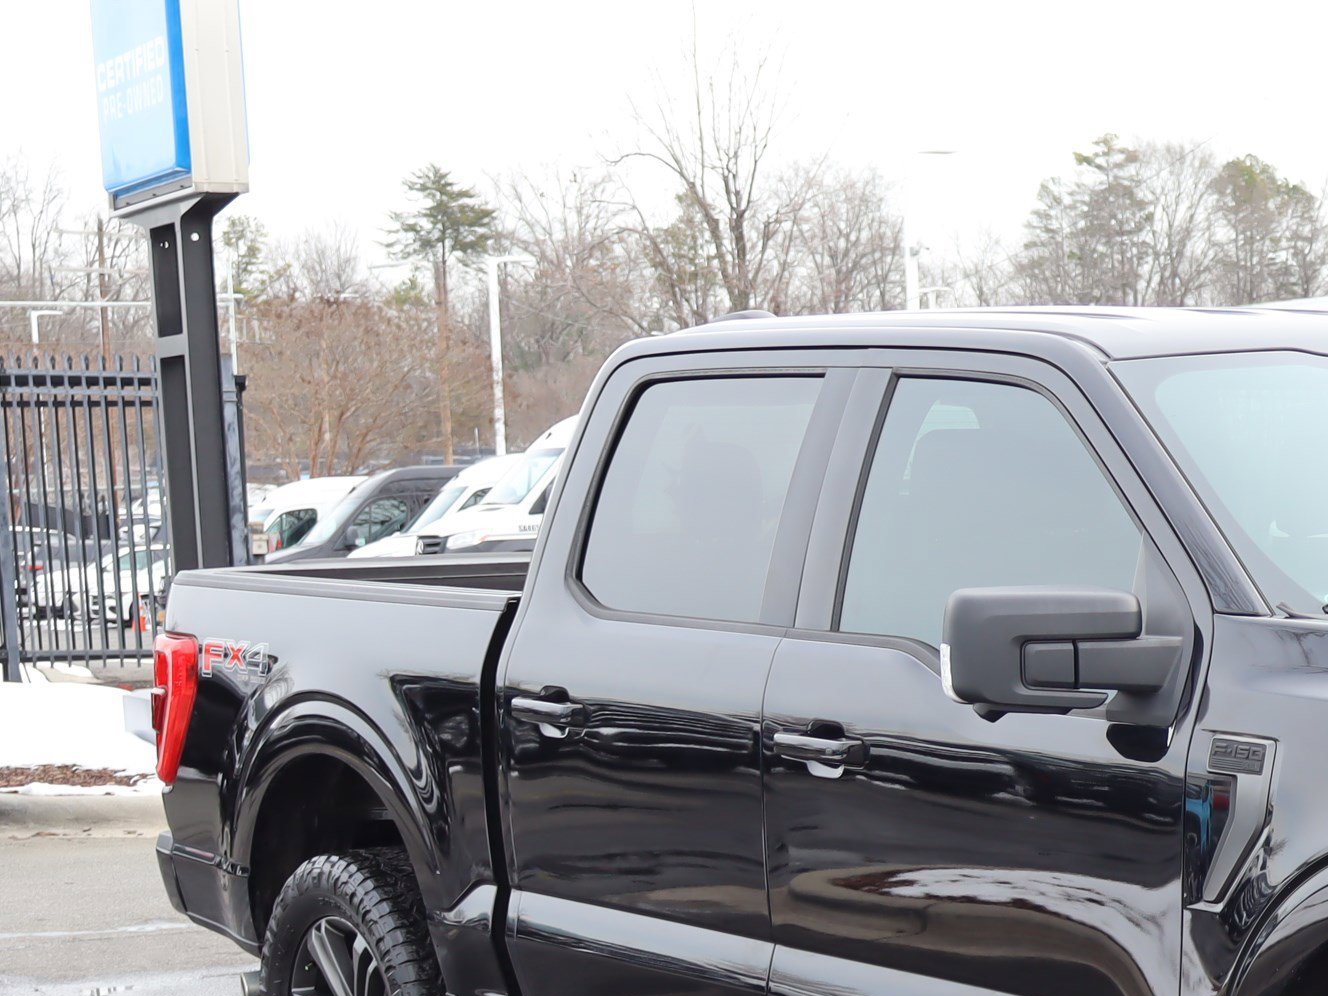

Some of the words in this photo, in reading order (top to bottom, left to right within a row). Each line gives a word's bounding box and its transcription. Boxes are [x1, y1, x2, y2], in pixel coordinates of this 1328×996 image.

[96, 36, 166, 93] CERTIFIED
[102, 74, 165, 122] PRE-OWNED
[201, 637, 269, 678] FX4
[1211, 742, 1264, 761] F-150
